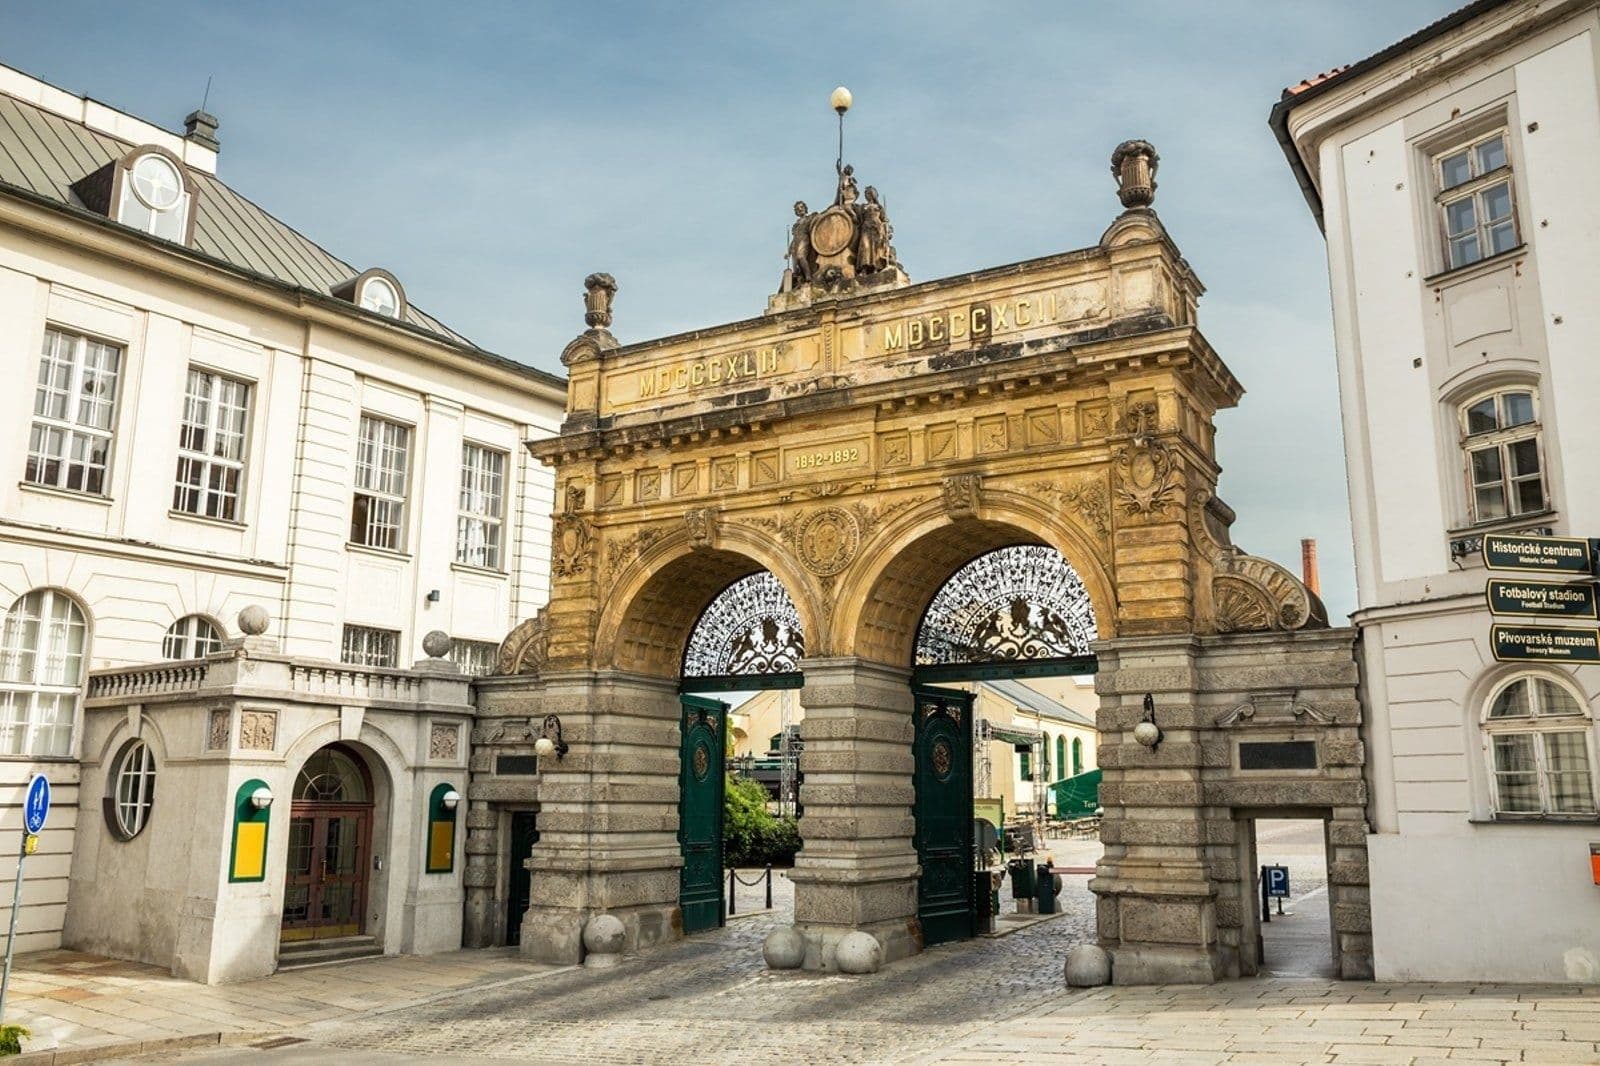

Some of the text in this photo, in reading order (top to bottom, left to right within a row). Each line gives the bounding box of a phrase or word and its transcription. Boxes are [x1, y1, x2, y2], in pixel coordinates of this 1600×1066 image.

[884, 294, 1057, 350] MDCCCXCII
[640, 348, 778, 397] MDCCCXLII
[795, 448, 859, 469] 1842-1892
[1492, 541, 1582, 557] Historické centrum
[1500, 587, 1585, 602] Fotbalový stadion
[1499, 632, 1595, 646] Pivovarské muzeum
[1271, 869, 1285, 888] P
